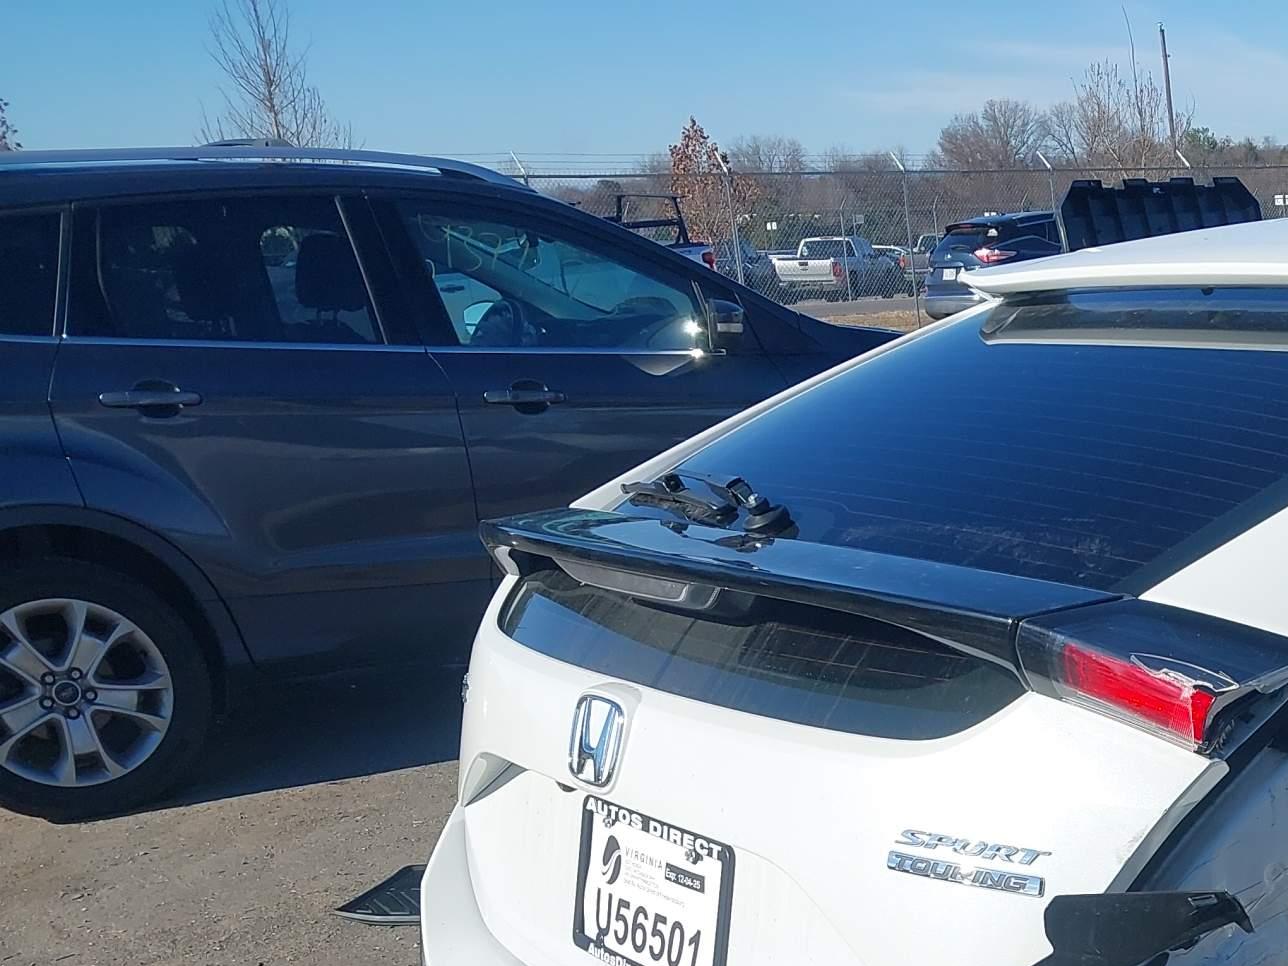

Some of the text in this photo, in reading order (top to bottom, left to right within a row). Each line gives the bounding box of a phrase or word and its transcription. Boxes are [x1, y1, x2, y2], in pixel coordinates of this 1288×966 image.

[585, 797, 723, 860] AUTOS DIRECT
[895, 829, 1053, 866] SPORT
[624, 846, 664, 870] VIRGINIA
[894, 852, 1031, 893] TOURING
